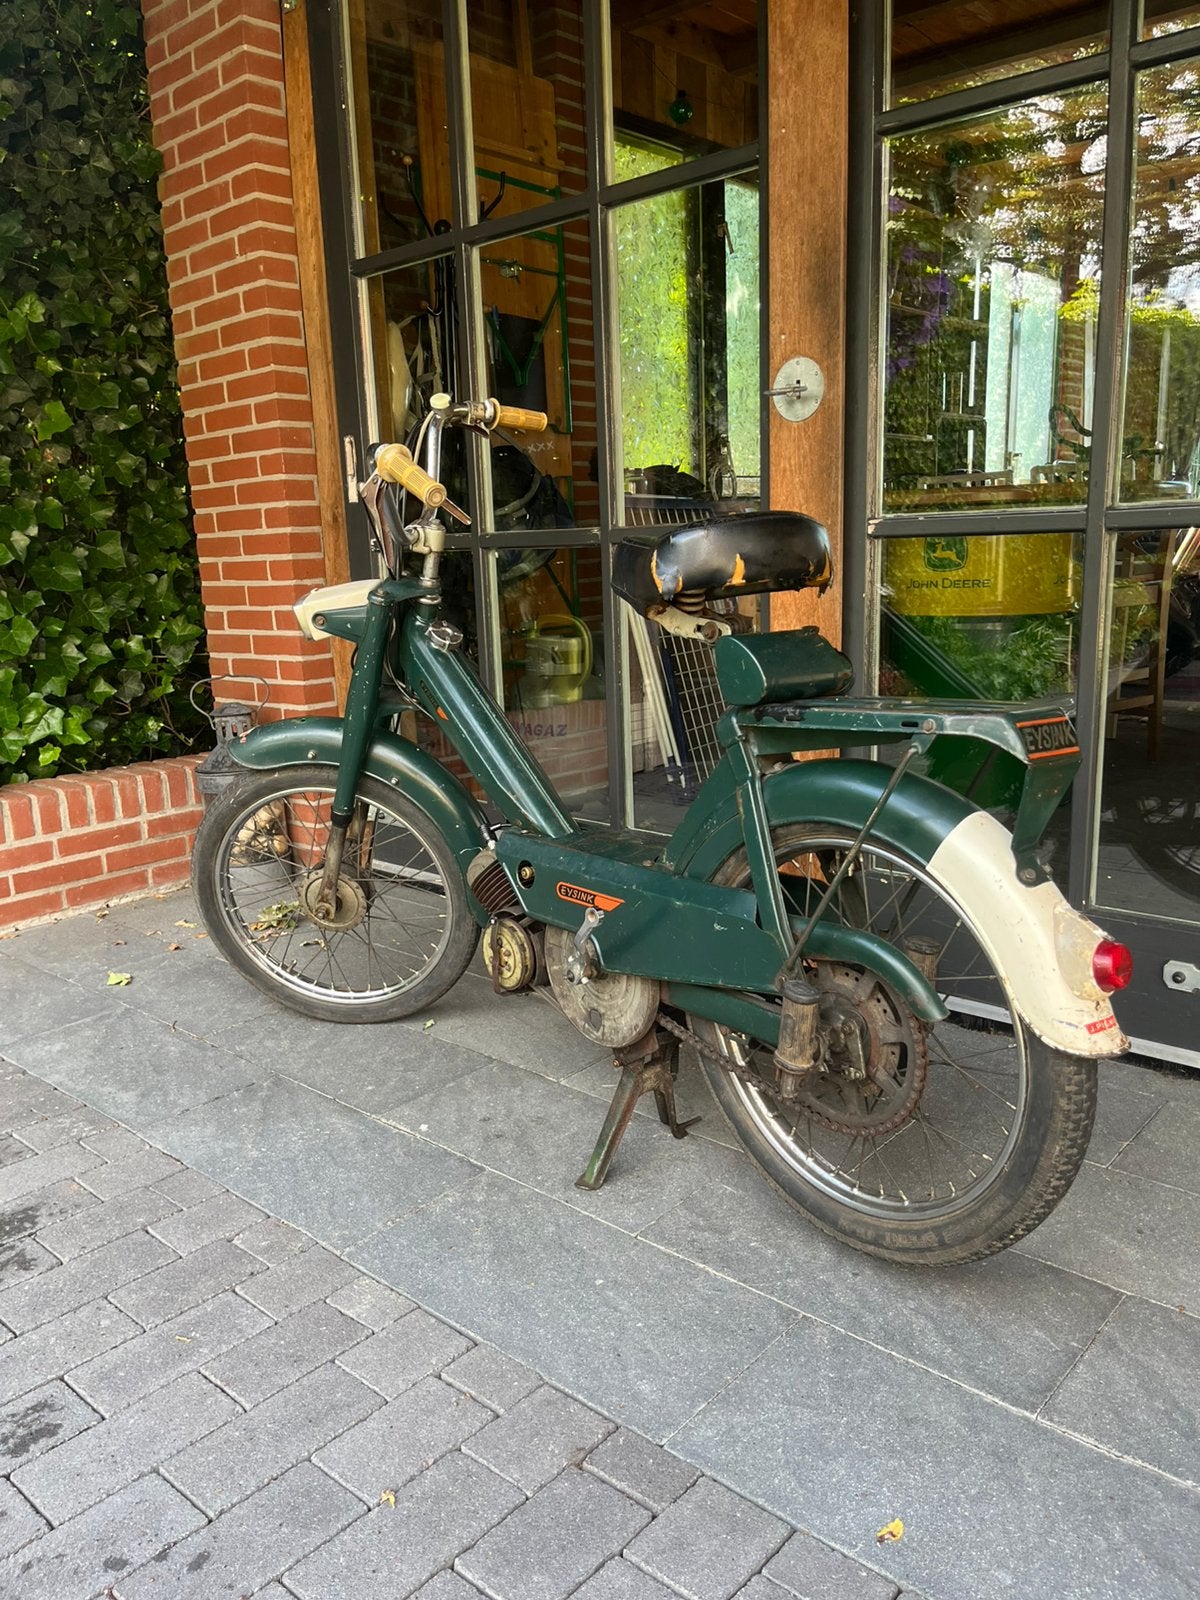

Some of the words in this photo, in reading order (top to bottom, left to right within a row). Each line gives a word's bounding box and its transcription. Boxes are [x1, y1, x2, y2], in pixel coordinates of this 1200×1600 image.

[907, 578, 939, 589] JOHN
[941, 577, 992, 589] DEERE
[1022, 721, 1077, 751] EYSINK
[560, 885, 595, 904] EYSINK
